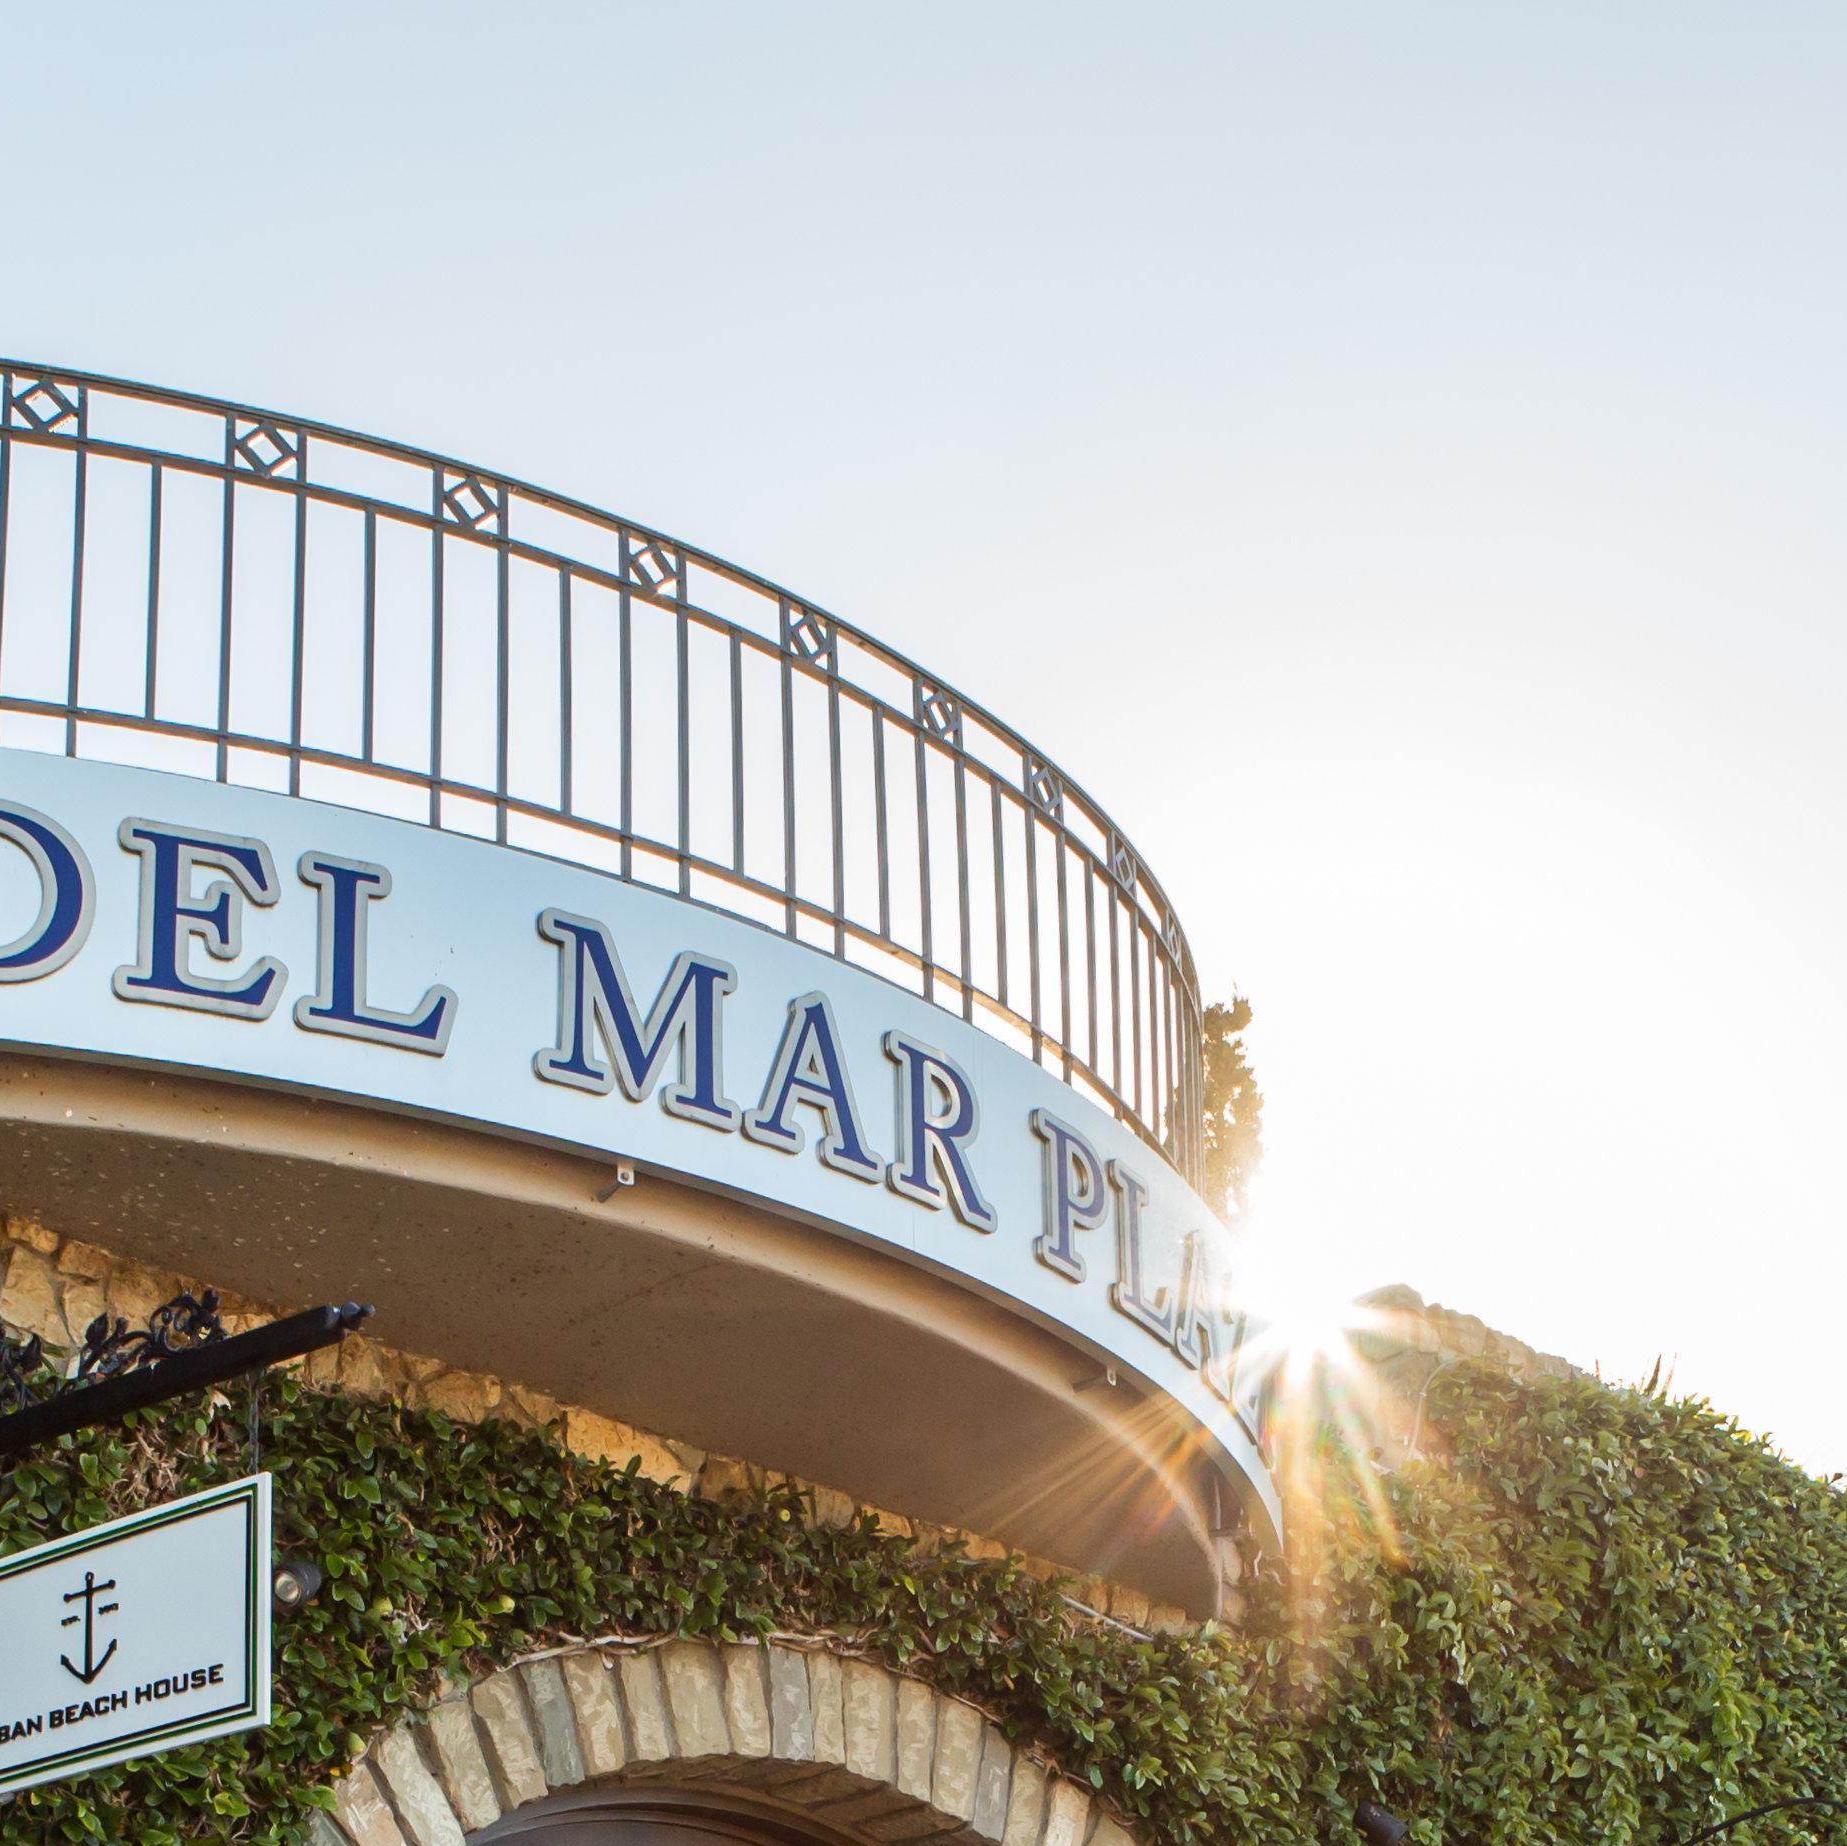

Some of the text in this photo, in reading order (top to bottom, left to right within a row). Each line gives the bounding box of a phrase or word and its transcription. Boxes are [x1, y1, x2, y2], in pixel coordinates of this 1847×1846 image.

[534, 907, 999, 1234] MAR
[1031, 1107, 1254, 1435] PLA
[49, 1690, 128, 1730] BEACH
[136, 1663, 224, 1705] HOUSE
